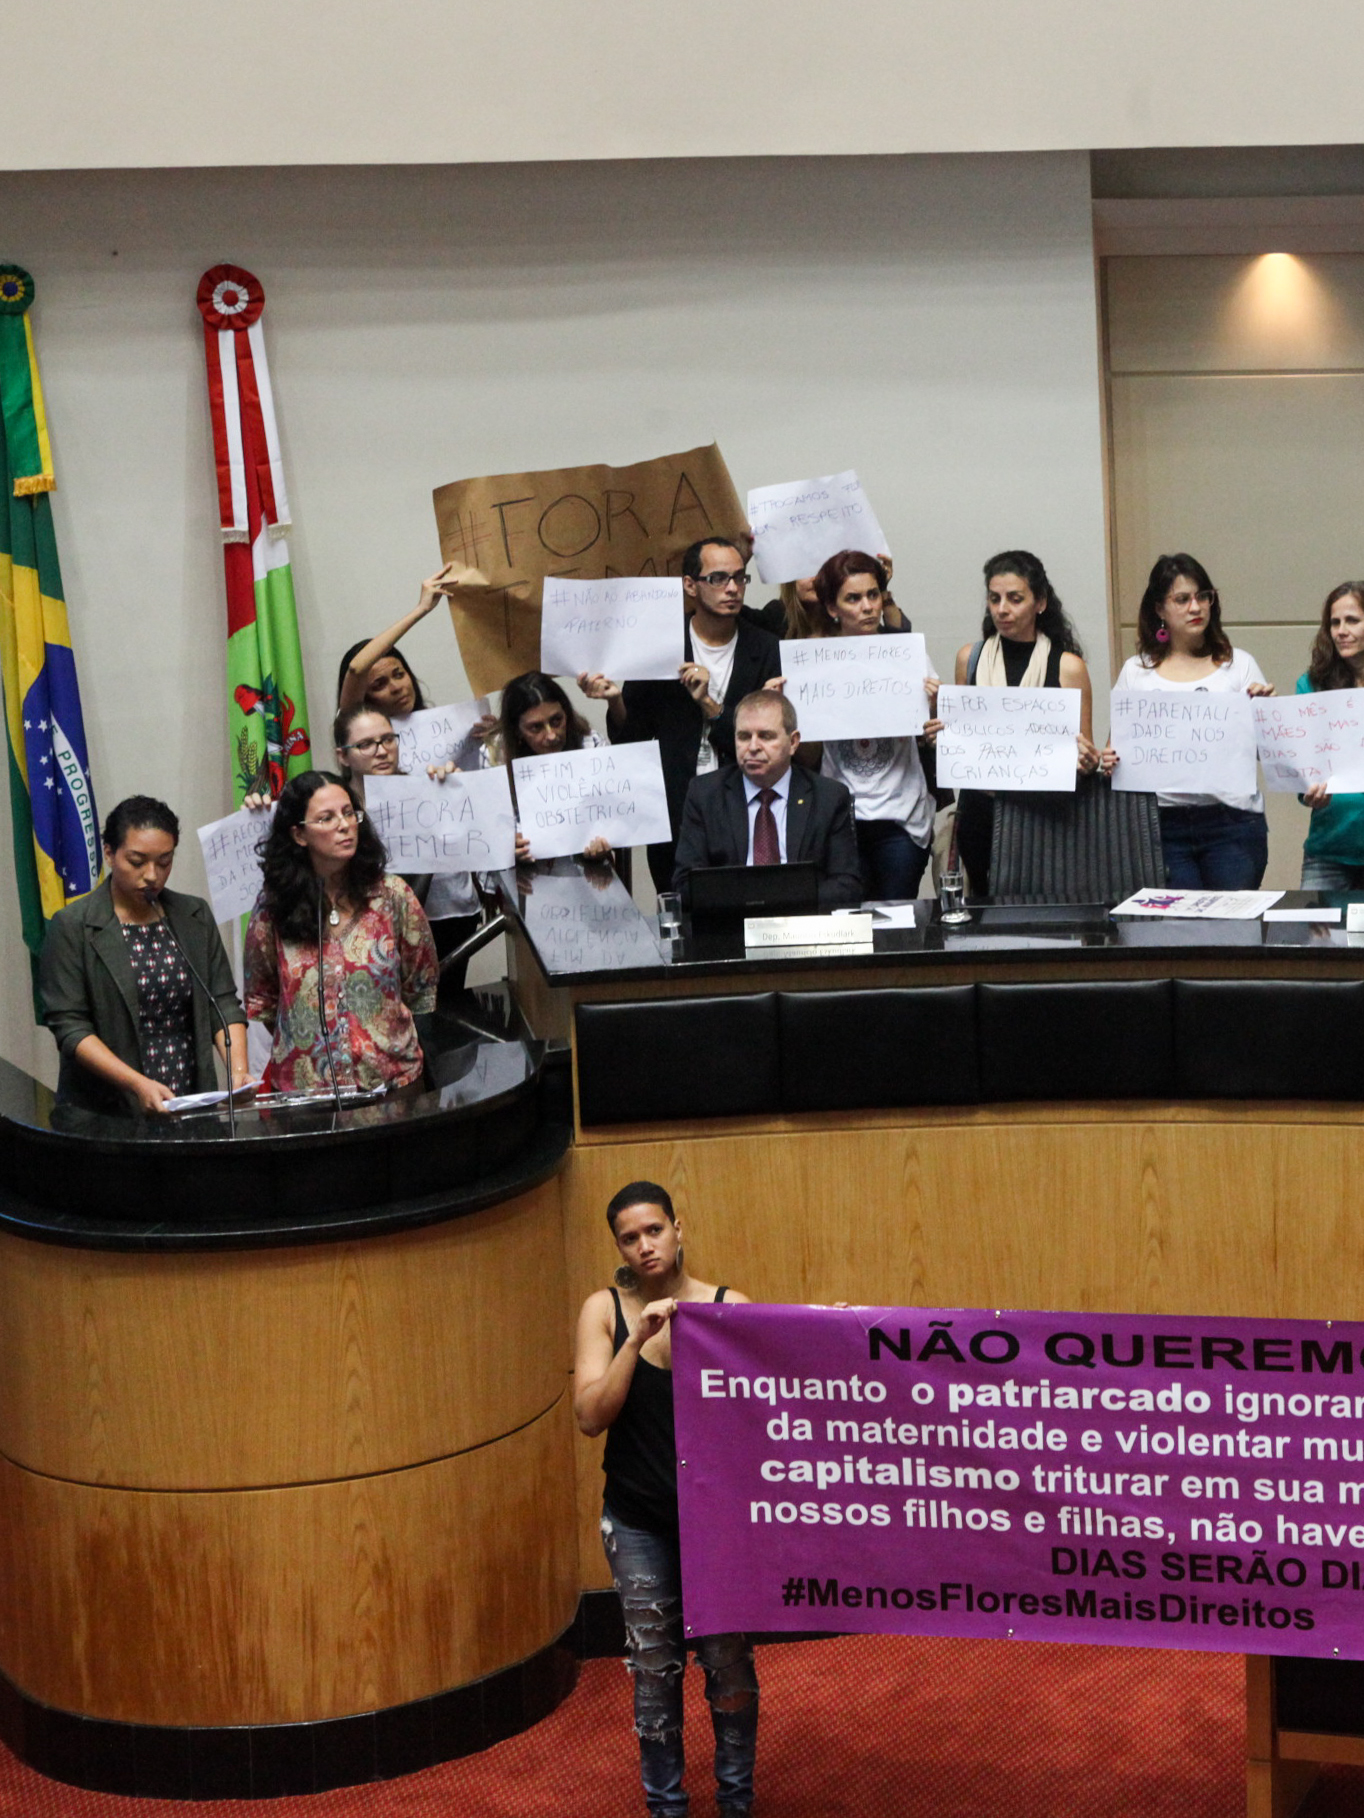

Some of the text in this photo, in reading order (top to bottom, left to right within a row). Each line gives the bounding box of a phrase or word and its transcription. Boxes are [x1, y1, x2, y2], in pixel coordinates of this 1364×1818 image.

[444, 472, 714, 568] #FORA
[789, 502, 863, 528] RESPEITO
[563, 615, 638, 634] PATERNO
[799, 682, 836, 706] MAIS
[1001, 697, 1066, 715] ESPAÇOS
[1298, 701, 1327, 718] MÊS
[430, 717, 453, 739] DA
[1131, 722, 1225, 742] DADE NOS
[1328, 719, 1358, 731] MAS
[940, 741, 1054, 761] DOS PARA AS
[1131, 745, 1208, 765] DIREITOS
[1262, 748, 1297, 759] DIAS
[590, 756, 615, 776] DA
[950, 761, 1049, 785] CRIANÇAS
[536, 776, 631, 803] VIOLÊNCIA
[868, 1320, 1020, 1365] NÃO
[700, 1369, 887, 1406] Enquanto
[911, 1382, 935, 1405] o
[948, 1378, 1212, 1414] patriarcado
[766, 1411, 813, 1441] da
[826, 1417, 1068, 1452] maternidade
[1080, 1429, 1103, 1453] e
[1114, 1424, 1292, 1459] violentar
[760, 1454, 1020, 1491] capitalismo
[1031, 1464, 1170, 1497] triturar
[1180, 1475, 1240, 1500] em
[1253, 1478, 1325, 1504] sua
[750, 1501, 891, 1527] nossos
[902, 1498, 1012, 1532] filhos
[1024, 1511, 1046, 1533] e
[1057, 1505, 1176, 1545] filhas,
[1190, 1512, 1263, 1544] não
[1050, 1546, 1147, 1580] DIAS
[1160, 1549, 1307, 1588] SERÃO
[781, 1575, 1315, 1631] #MenosFloresMaisDireitos
